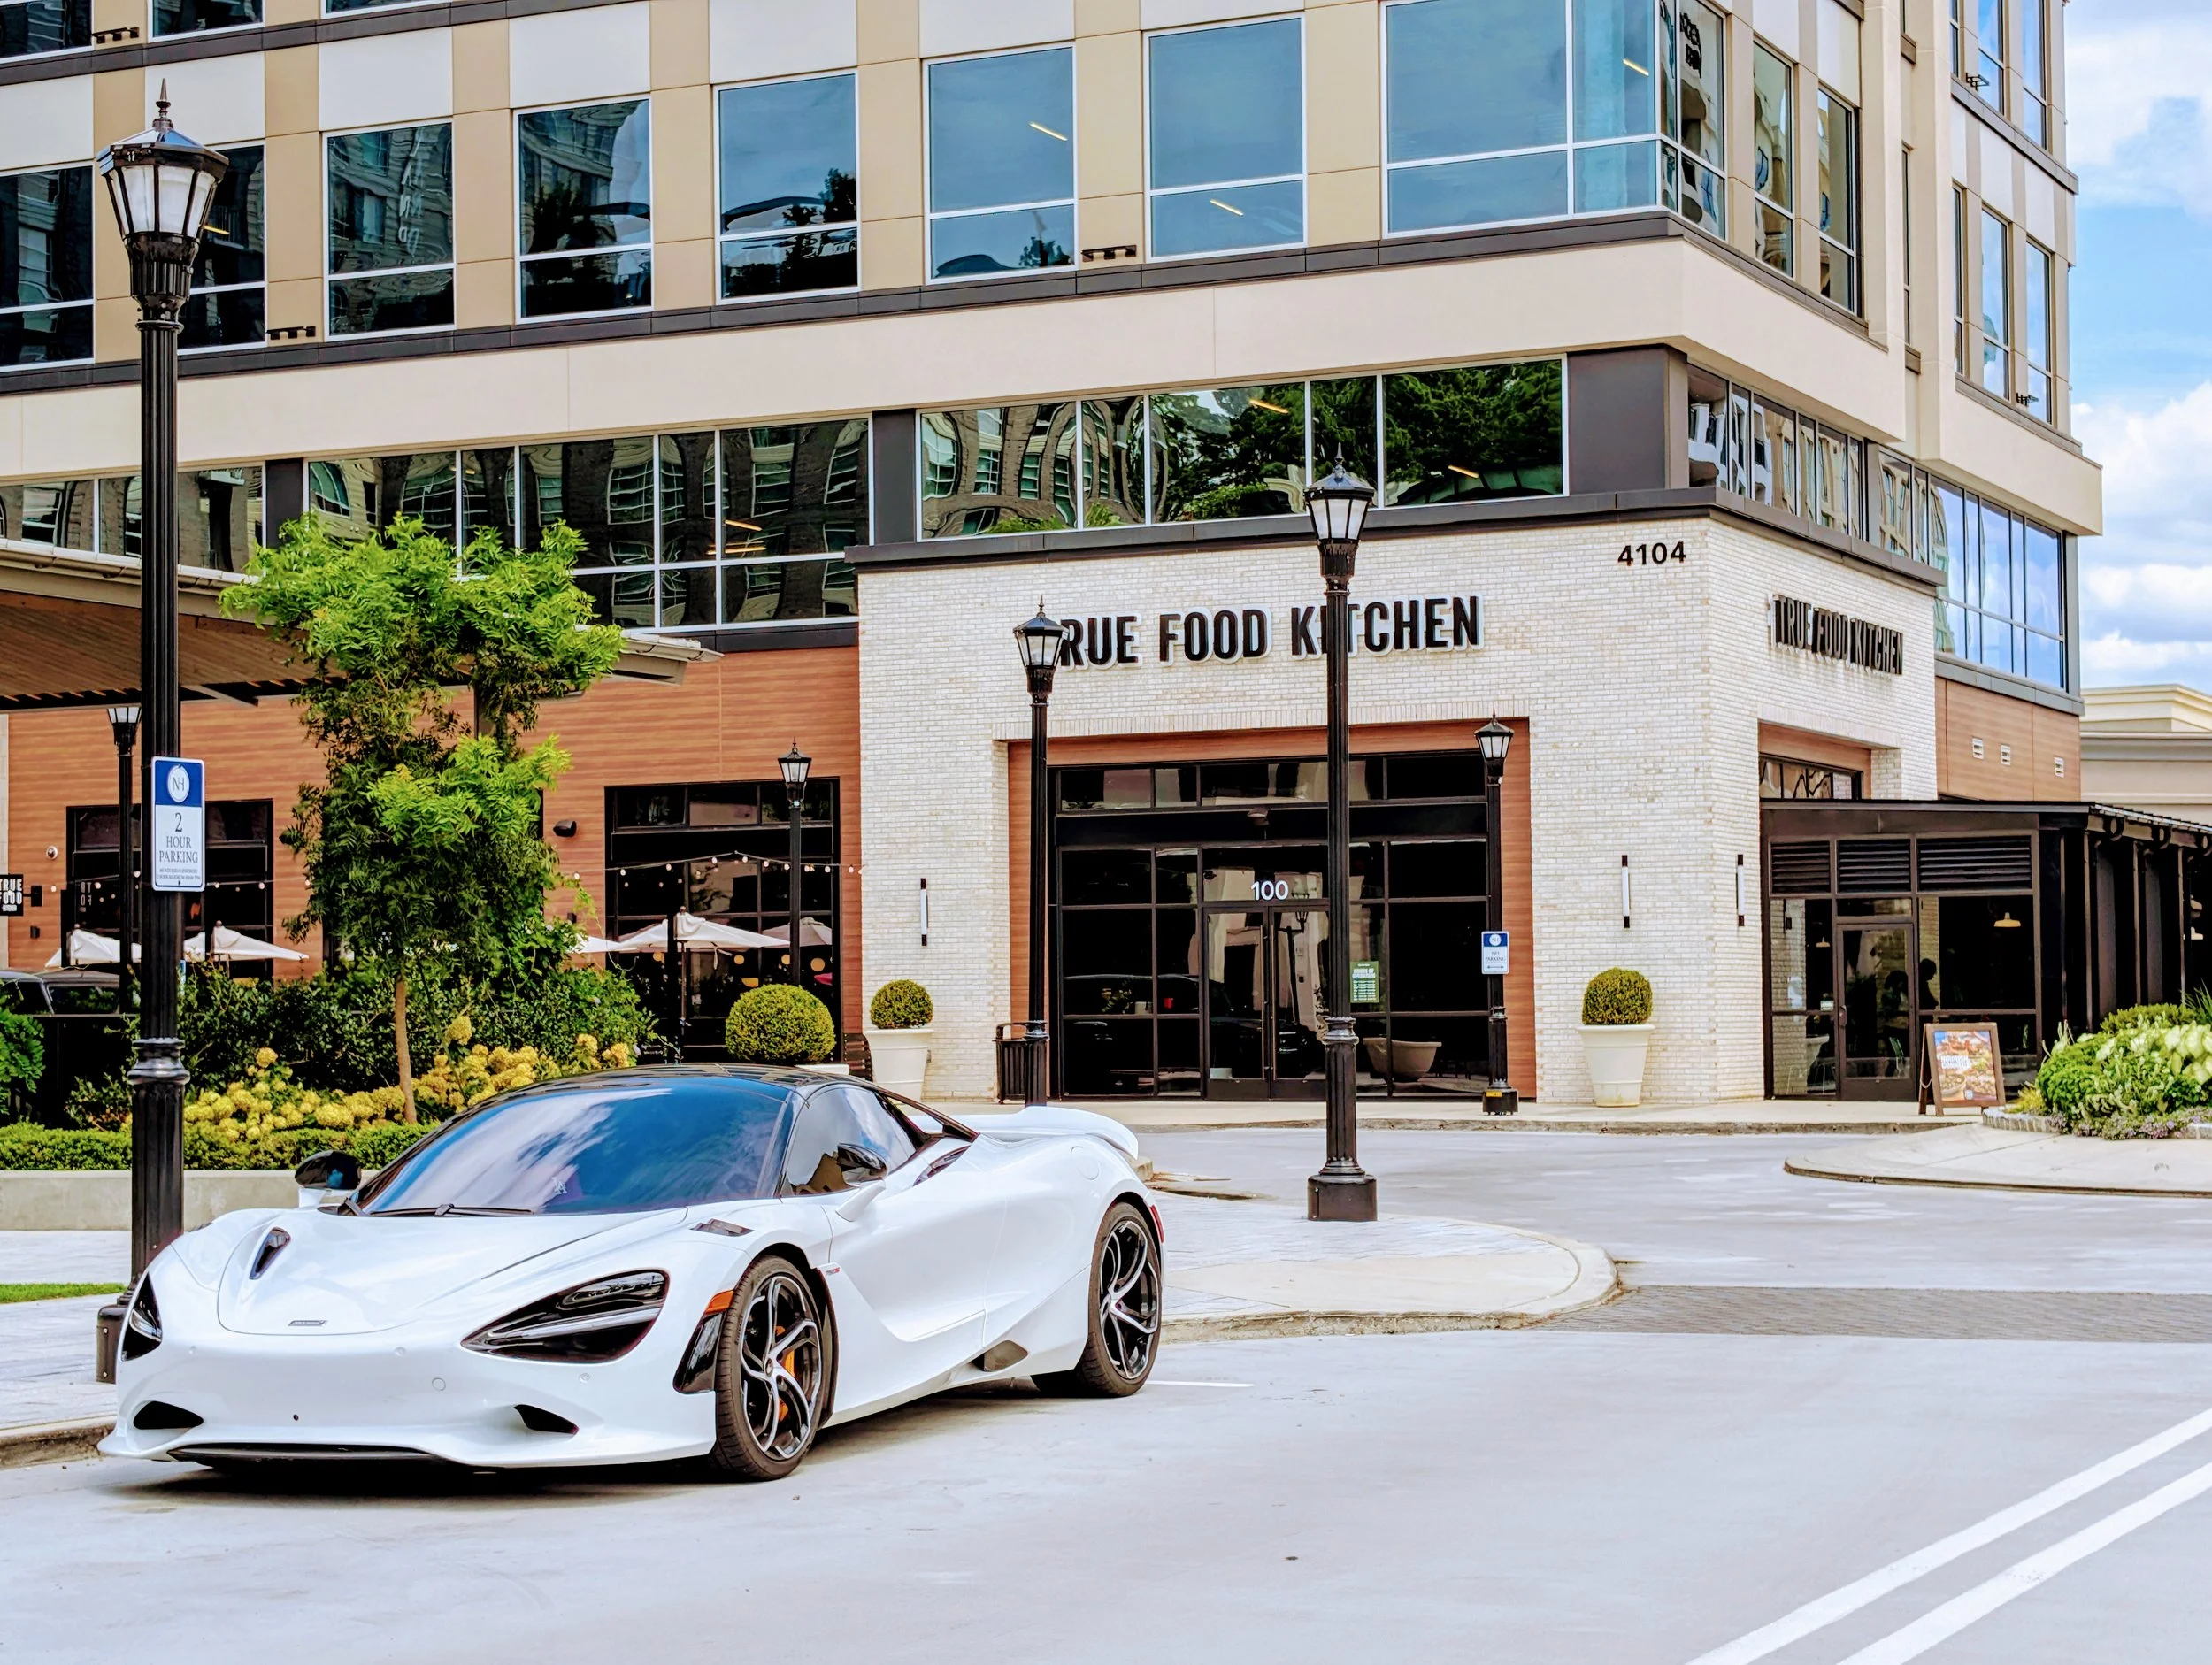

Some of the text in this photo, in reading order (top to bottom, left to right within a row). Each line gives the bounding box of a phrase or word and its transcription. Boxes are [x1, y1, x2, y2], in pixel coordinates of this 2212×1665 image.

[1617, 541, 1686, 566] 4104
[1061, 614, 1139, 666] RUE
[1159, 608, 1269, 663] FOOD
[1772, 595, 1904, 675] TRUE FOOD KITCHEN
[174, 812, 183, 832] 2
[166, 836, 191, 848] HOUR
[158, 850, 198, 863] PARKING
[1250, 879, 1289, 901] 100
